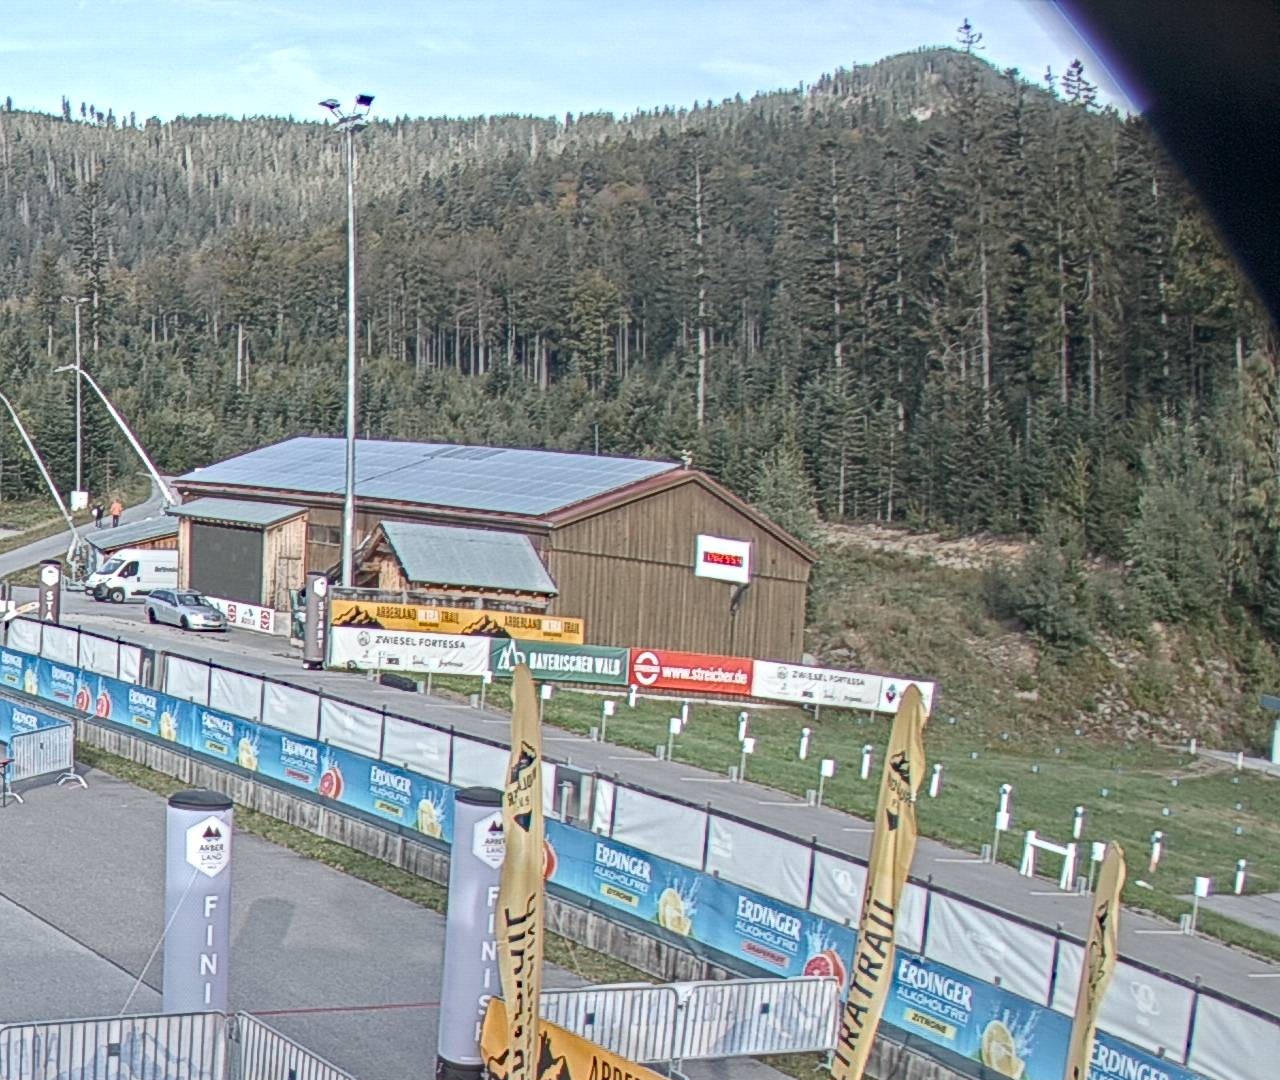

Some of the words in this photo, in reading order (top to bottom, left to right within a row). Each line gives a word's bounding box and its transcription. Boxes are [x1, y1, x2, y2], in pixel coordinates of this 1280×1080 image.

[375, 635, 417, 646] ZWIESEL
[419, 638, 466, 649] FORTESSA
[530, 652, 594, 673] BAYERISCHER
[595, 657, 621, 675] WALD
[662, 664, 748, 685] www.streicher.de
[595, 842, 652, 883] ERDINGER
[738, 896, 802, 941] ERDINGER
[200, 895, 219, 1004] FINI
[899, 958, 974, 1012] ERDINGER
[896, 987, 969, 1024] ALKOHOLFREI
[911, 1012, 948, 1035] ZITRONE
